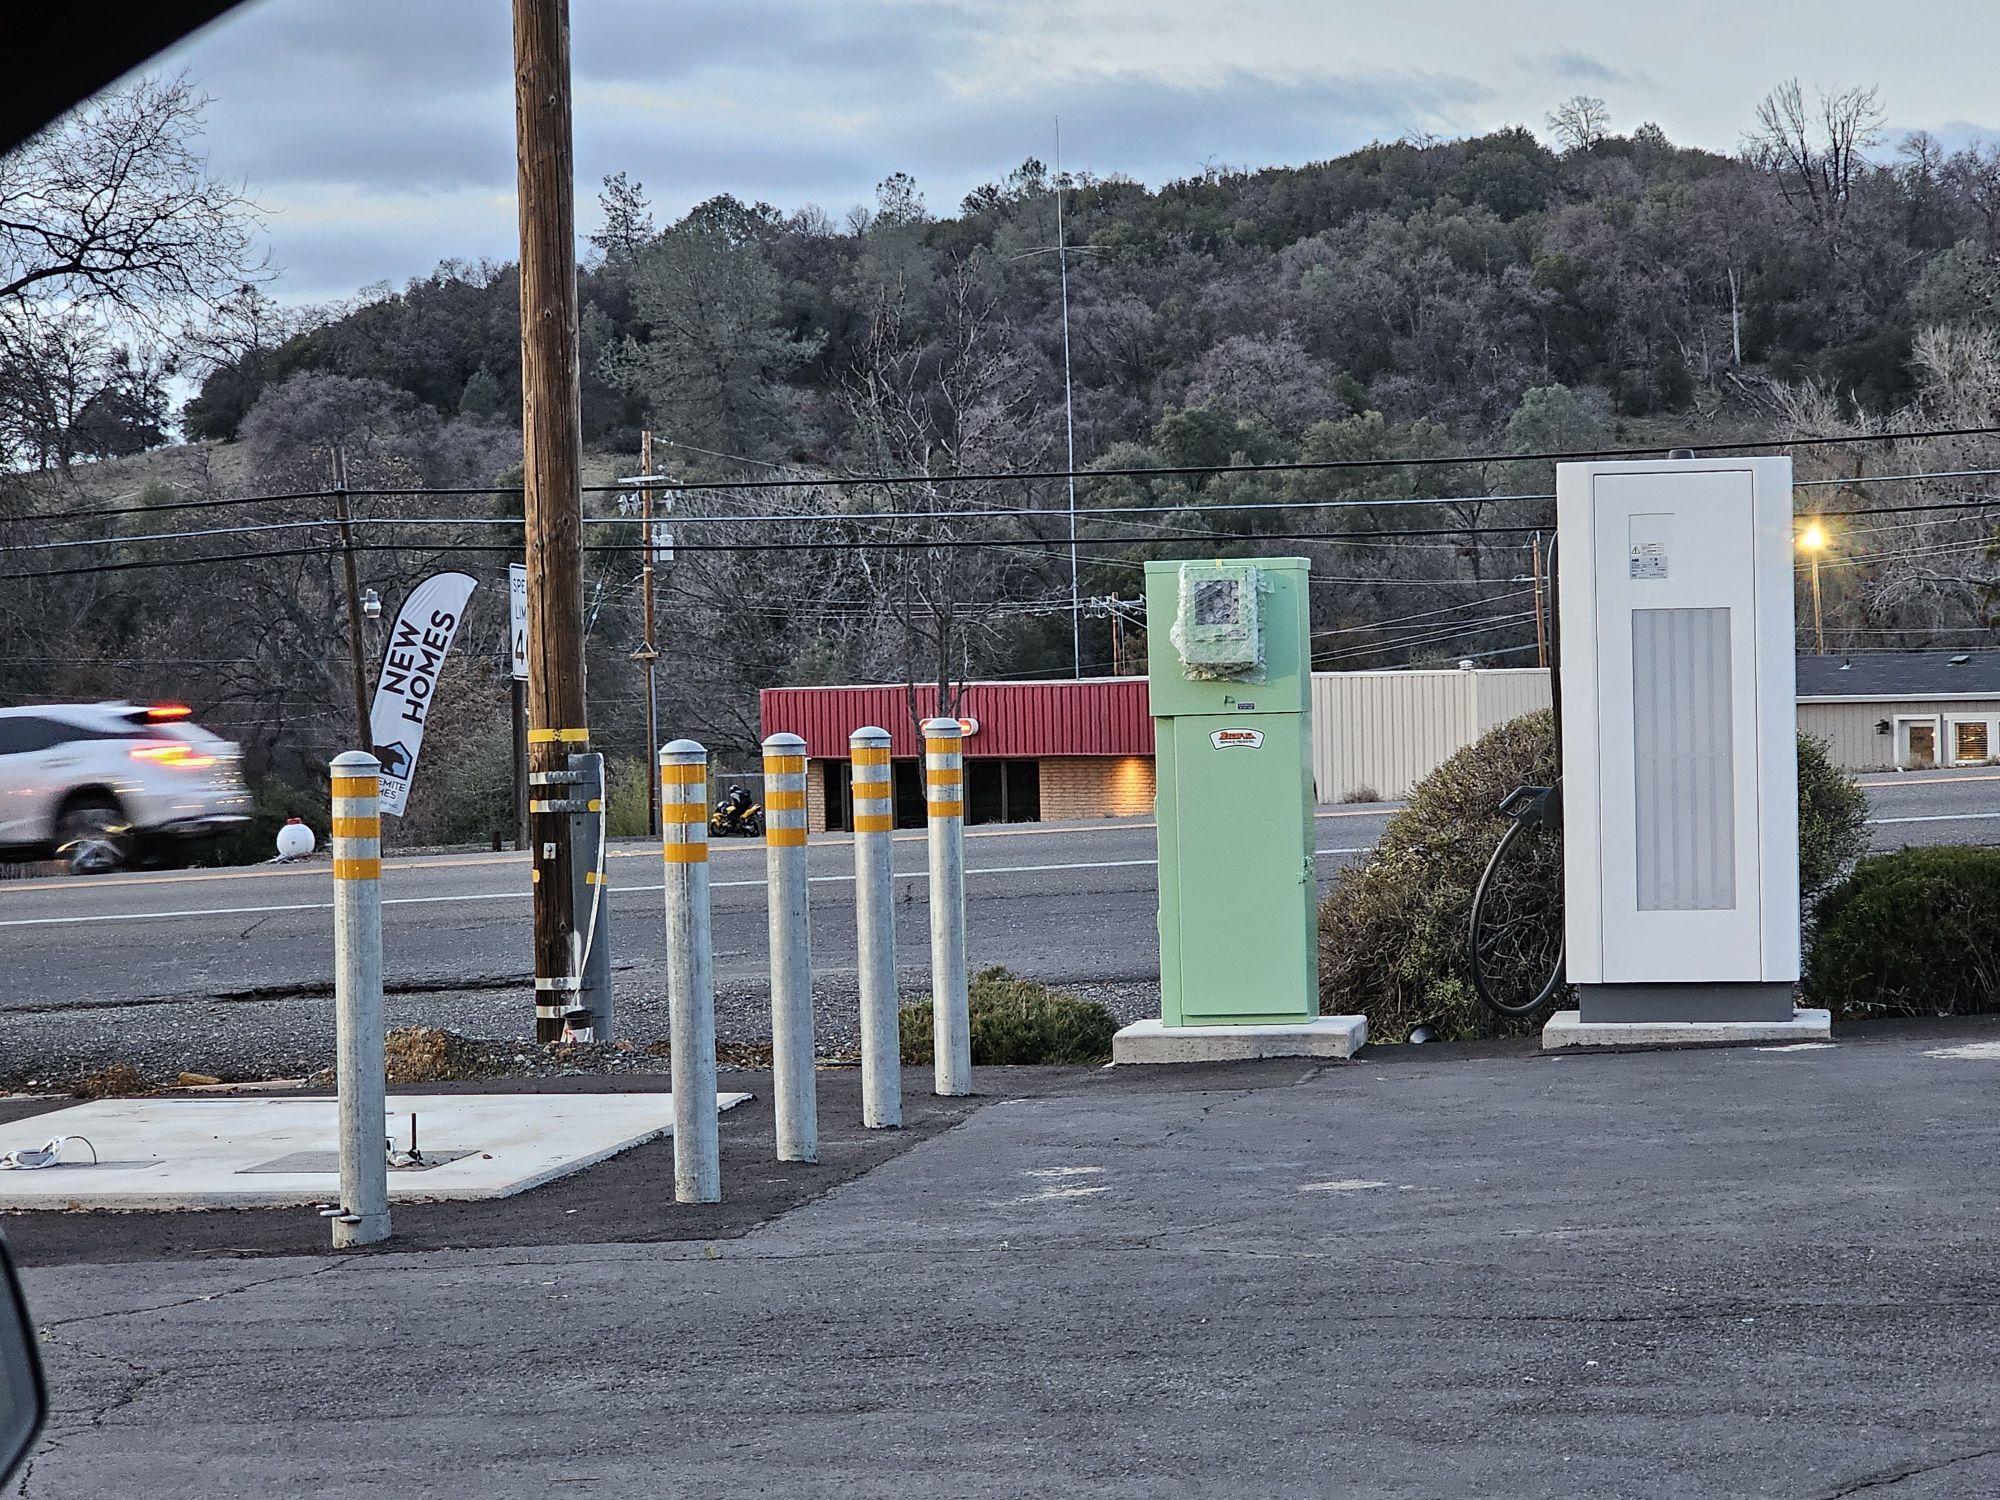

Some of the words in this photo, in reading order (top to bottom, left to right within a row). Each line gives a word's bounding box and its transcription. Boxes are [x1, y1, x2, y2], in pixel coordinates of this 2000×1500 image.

[512, 578, 525, 594] SPE
[515, 604, 526, 620] LIM
[381, 619, 421, 696] NEW
[515, 629, 529, 666] 4
[402, 609, 455, 724] HOMES
